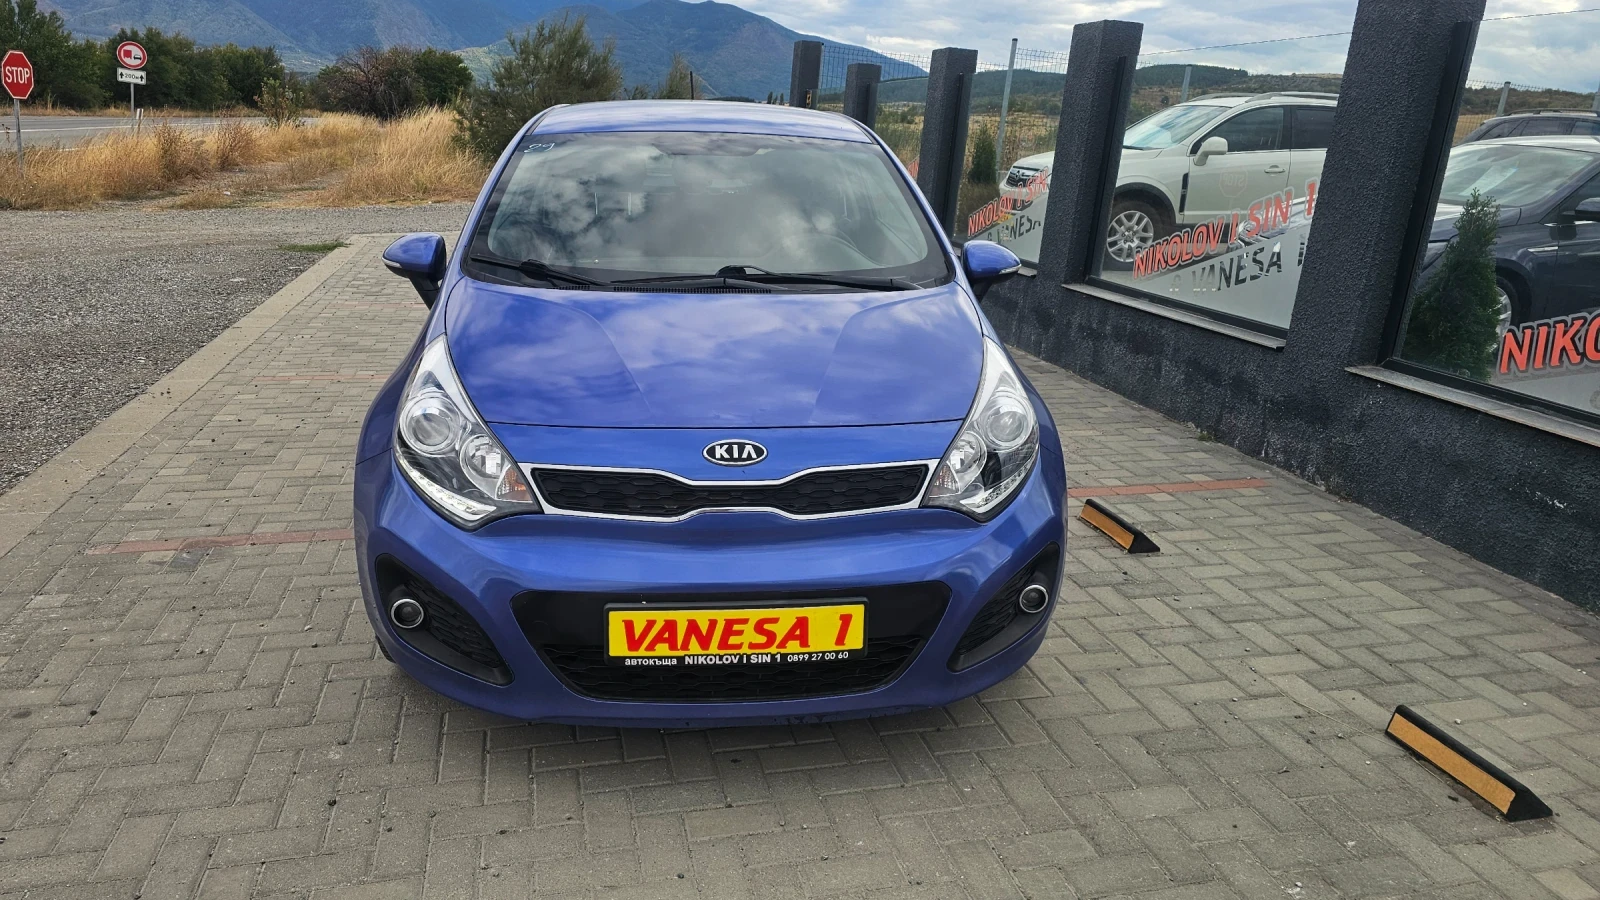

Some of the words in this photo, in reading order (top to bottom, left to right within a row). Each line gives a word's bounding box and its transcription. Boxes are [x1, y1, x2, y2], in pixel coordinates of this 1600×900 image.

[5, 66, 31, 84] STOP
[1133, 217, 1225, 280] NIKOLOV
[1247, 190, 1292, 237] SIN
[1192, 242, 1283, 296] VANESA
[715, 444, 758, 459] KIA
[621, 615, 811, 652] VANESA
[833, 613, 853, 646] 1
[624, 657, 678, 666] автокъща
[684, 654, 740, 665] NIKOLOV
[750, 654, 771, 664] SIN
[775, 653, 781, 662] 1
[787, 653, 809, 662] 0899
[811, 652, 823, 661] 27
[824, 652, 836, 660] 00
[838, 651, 849, 659] 60
